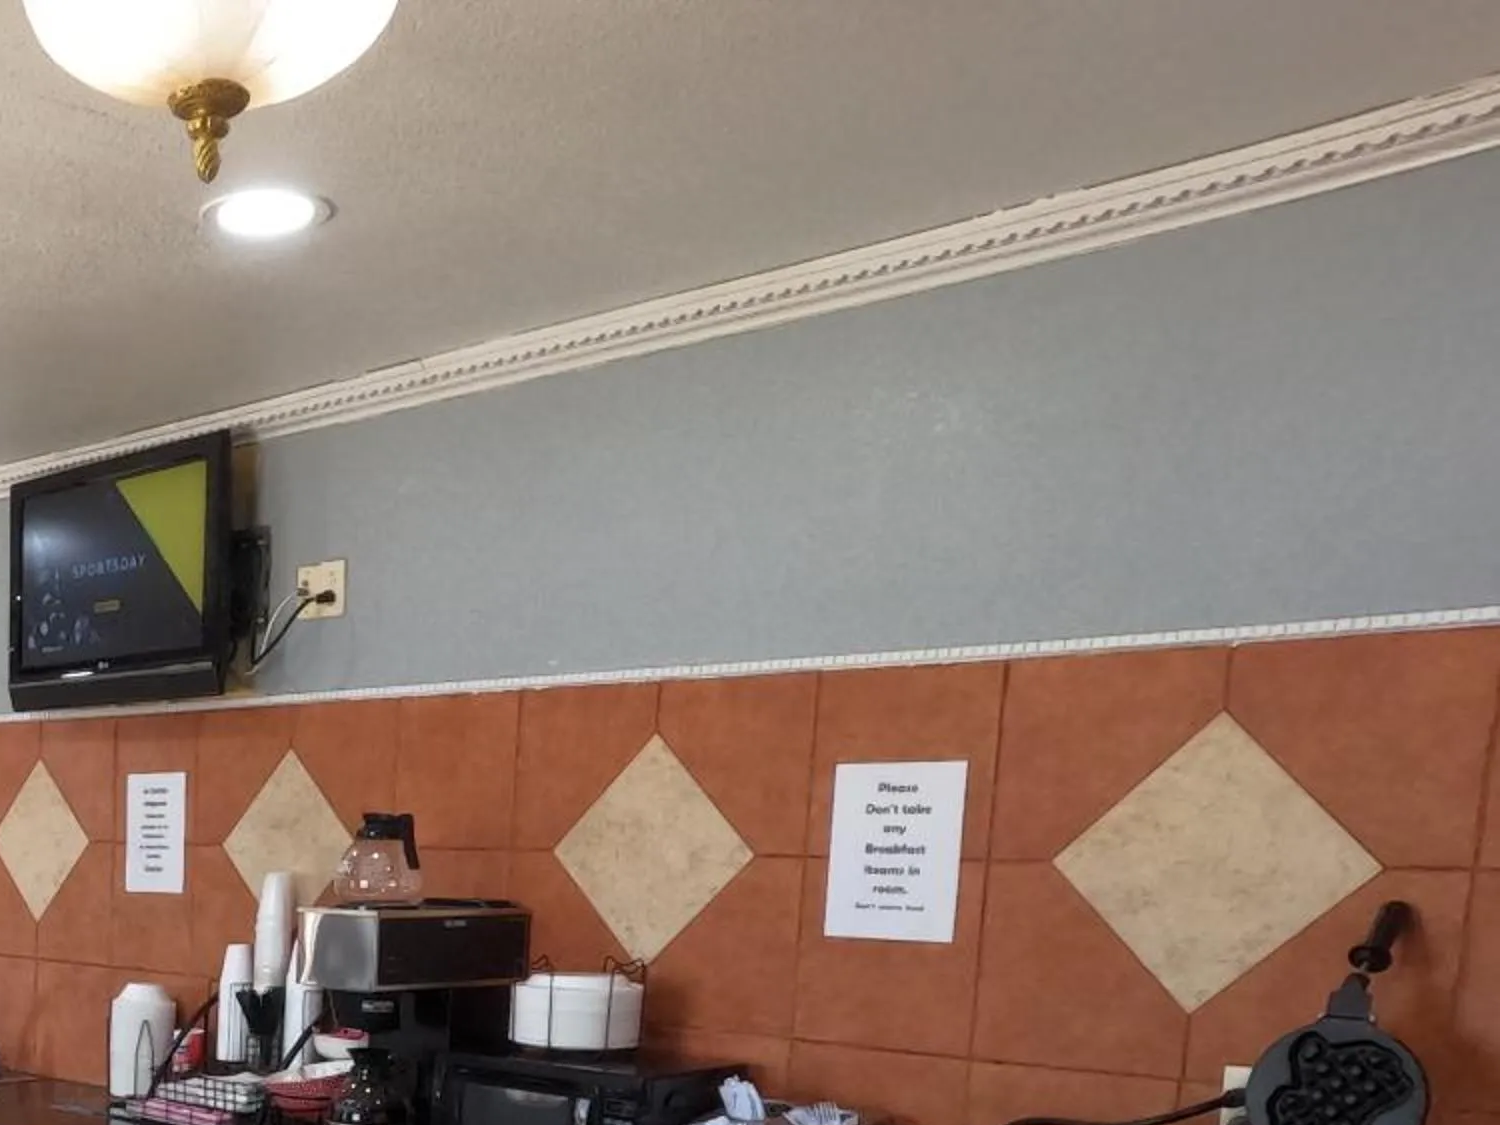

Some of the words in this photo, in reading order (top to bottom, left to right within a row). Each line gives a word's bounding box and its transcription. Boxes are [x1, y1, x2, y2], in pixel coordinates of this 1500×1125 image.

[72, 552, 147, 579] SPORTSDAY
[877, 782, 919, 793] Please
[865, 803, 899, 815] Don't
[902, 803, 933, 815] take
[883, 825, 907, 835] any
[865, 843, 926, 855] Breakfast
